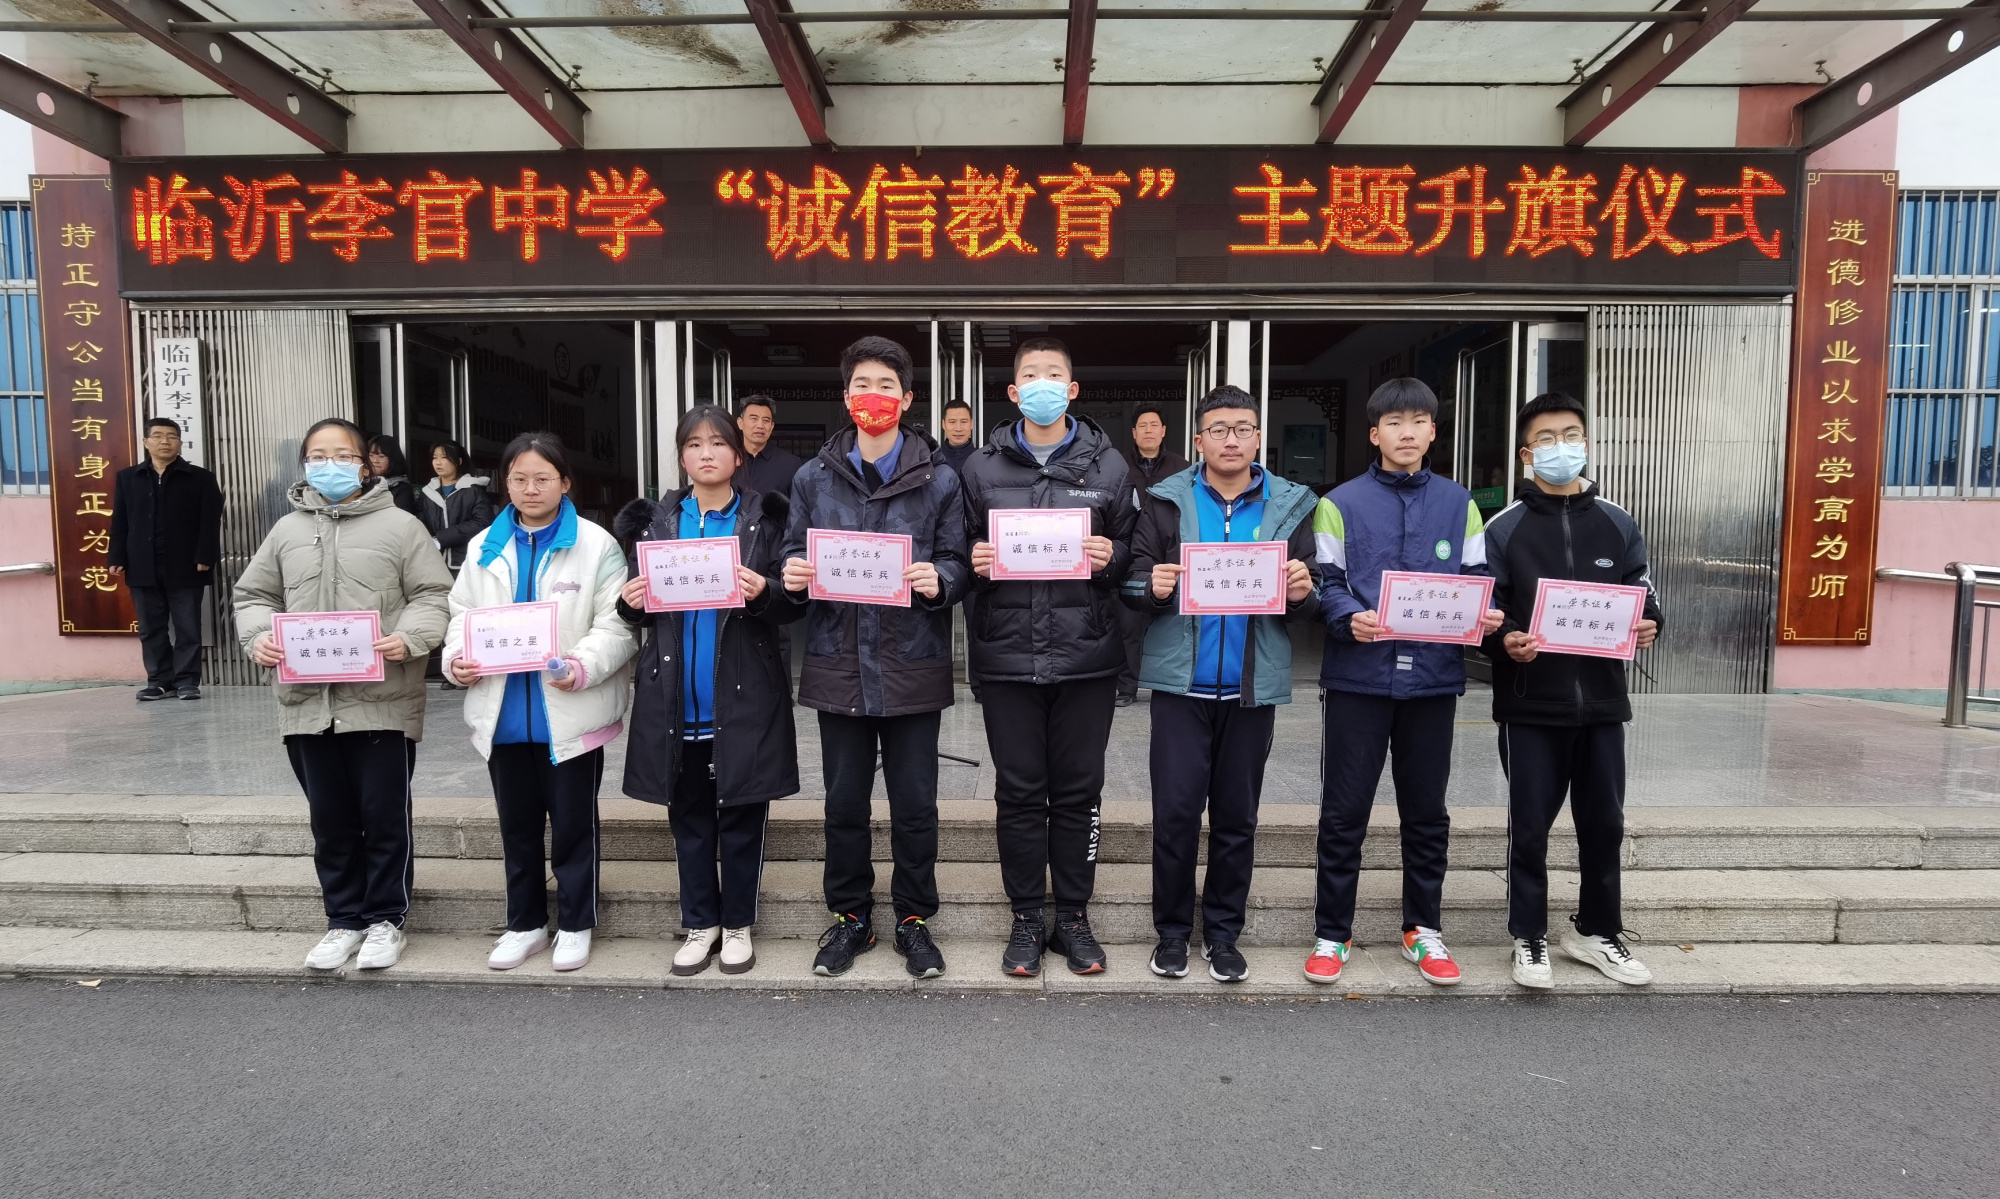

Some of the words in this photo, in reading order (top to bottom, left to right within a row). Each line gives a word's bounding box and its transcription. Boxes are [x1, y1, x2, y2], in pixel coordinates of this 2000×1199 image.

[134, 168, 664, 264] 临沂李官中学
[717, 162, 1177, 260] “诚信教育”
[1228, 163, 1786, 260] 主题升旗仪式
[61, 223, 118, 592] 持正守公当有身正为范
[1808, 219, 1867, 599] 进德修业以求学高为师
[840, 548, 881, 559] 荣誉证书
[1012, 543, 1069, 554] 诚信标兵
[1213, 558, 1256, 568] 荣誉证书
[831, 567, 888, 580] 诚信标兵
[663, 574, 720, 586] 诚信标兵
[1204, 579, 1262, 589] 诚信标兵
[1415, 589, 1460, 600] 荣誉证书
[1569, 597, 1612, 609] 荣誉证书
[1402, 609, 1463, 620] 诚信标兵
[1556, 617, 1615, 631] 诚信标兵
[306, 627, 349, 637] 荣誉证书
[485, 636, 537, 648] 诚信之星
[300, 647, 359, 658] 诚信标兵
[1087, 805, 1100, 861] TRAIN
